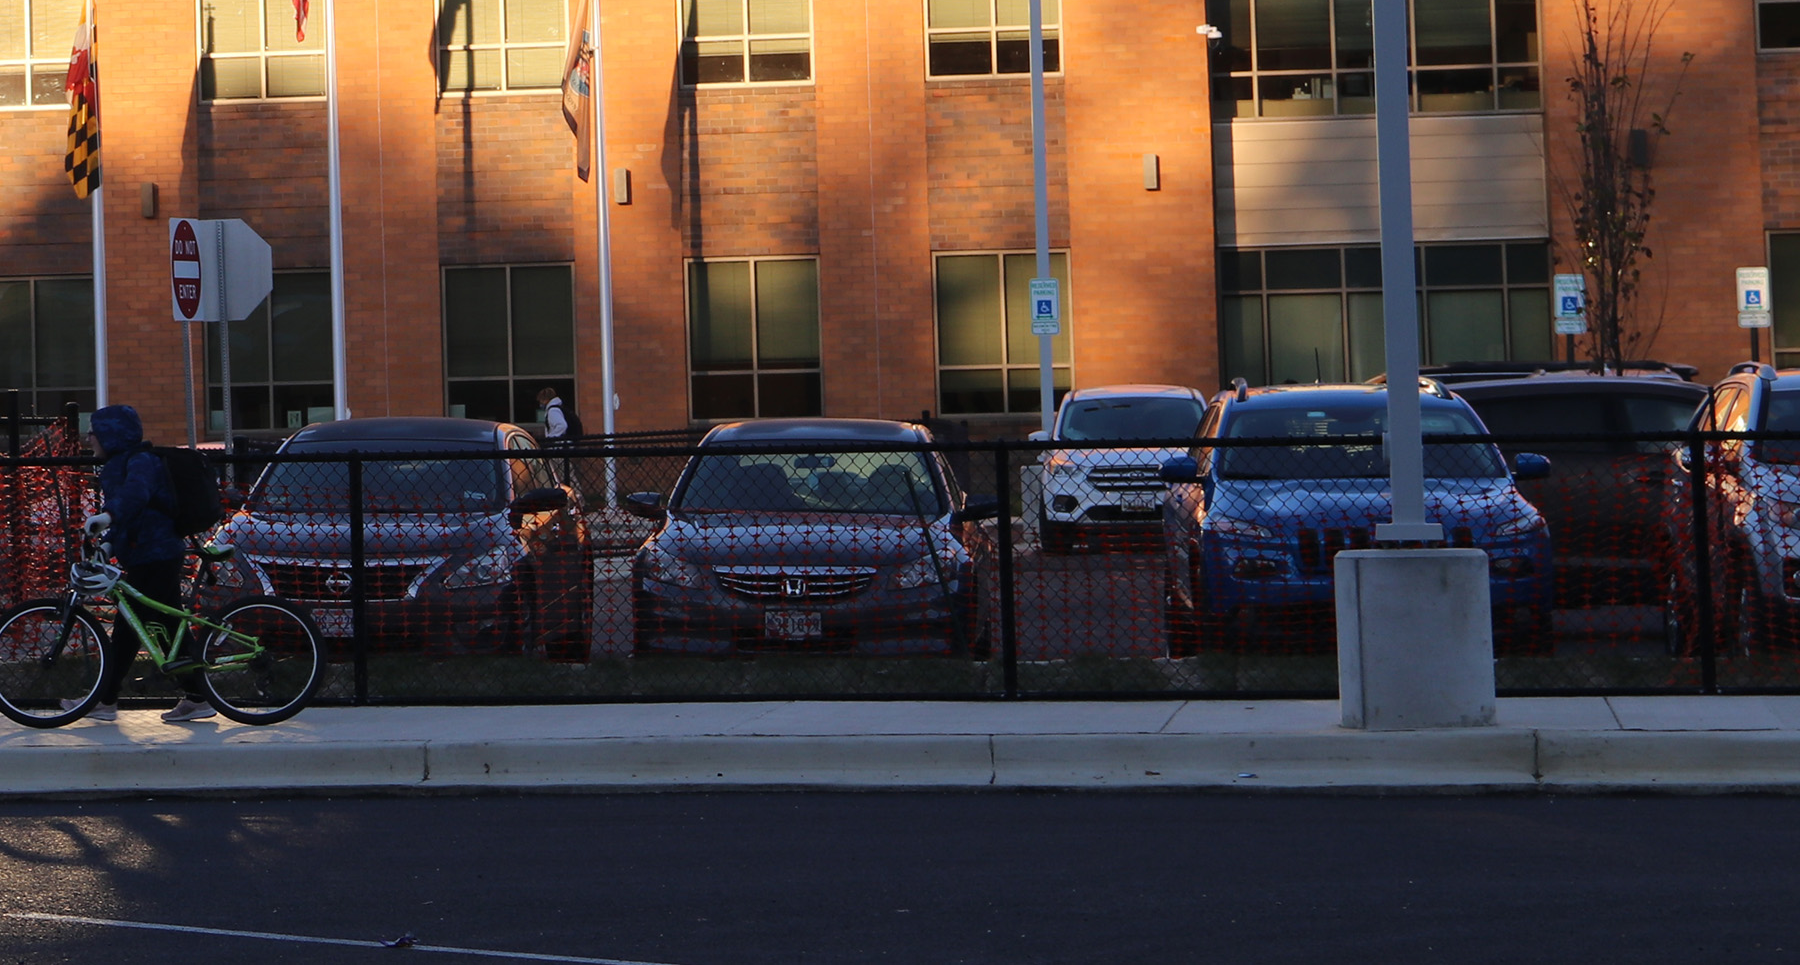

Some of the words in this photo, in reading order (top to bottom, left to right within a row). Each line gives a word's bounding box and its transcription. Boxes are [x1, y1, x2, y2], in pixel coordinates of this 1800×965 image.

[175, 239, 183, 254] DO
[185, 240, 196, 255] NOT
[179, 284, 196, 299] ENTER
